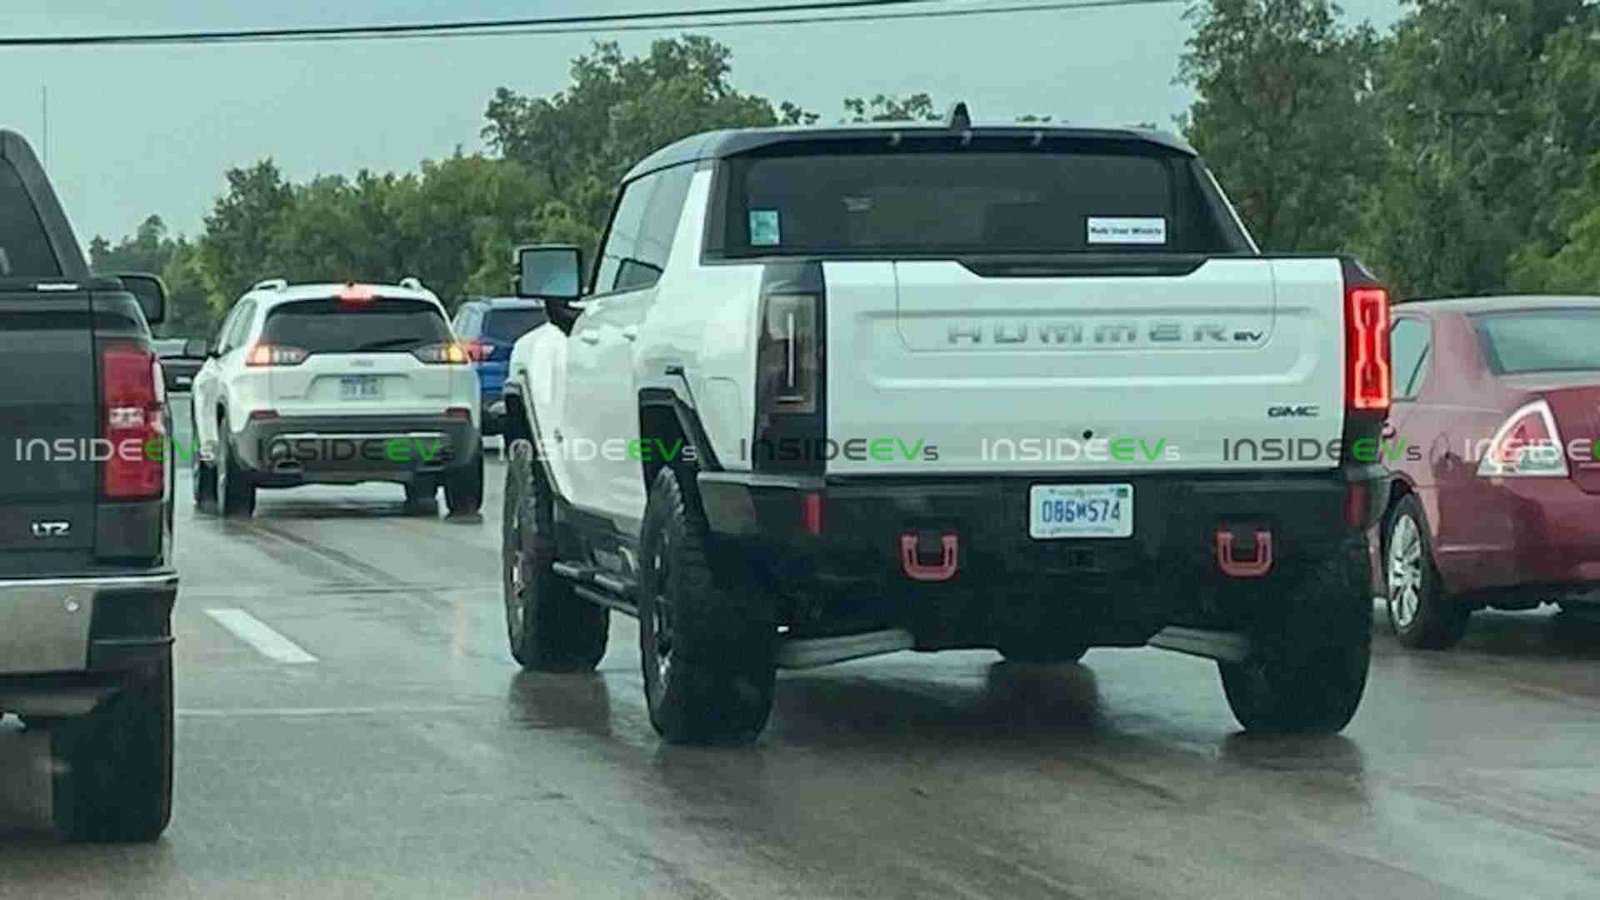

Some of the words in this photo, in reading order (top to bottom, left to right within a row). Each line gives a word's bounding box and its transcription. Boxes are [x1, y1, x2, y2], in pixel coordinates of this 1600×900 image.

[947, 322, 1228, 344] HUMMER
[1233, 330, 1264, 342] EV
[1267, 405, 1320, 418] GMC
[32, 521, 70, 537] LTZ
